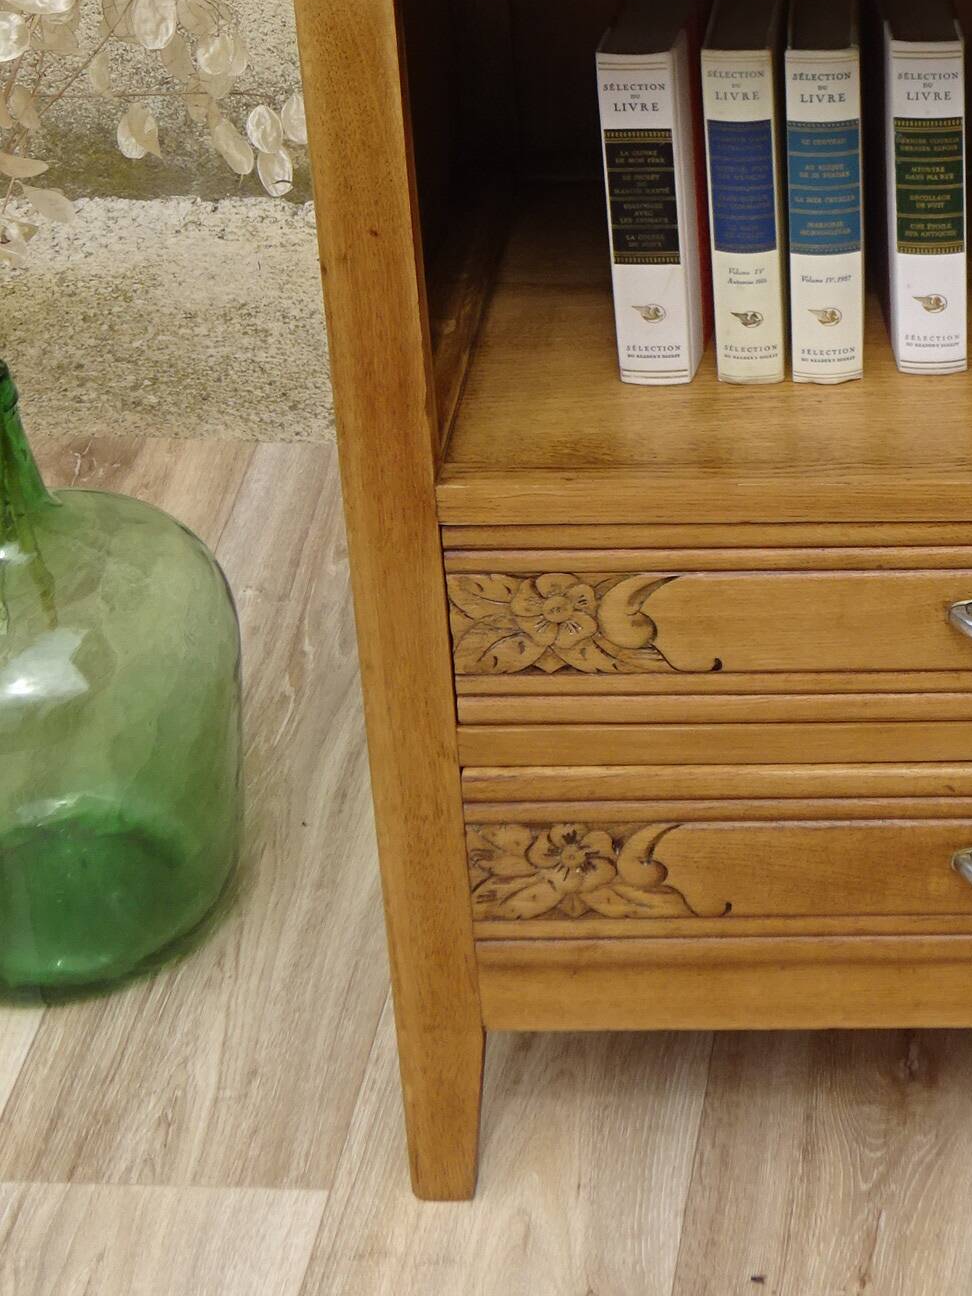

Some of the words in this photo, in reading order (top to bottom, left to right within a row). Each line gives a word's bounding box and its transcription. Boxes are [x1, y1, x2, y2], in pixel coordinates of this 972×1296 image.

[706, 70, 765, 79] SÉLECTION
[792, 71, 851, 81] SÉLECTION
[897, 71, 959, 81] SÉLECTION
[602, 82, 666, 92] SÉLECTION
[715, 90, 760, 101] LIVRE
[800, 93, 847, 103] LIVRE
[906, 91, 952, 101] LIVRE
[613, 102, 660, 112] LIVRE
